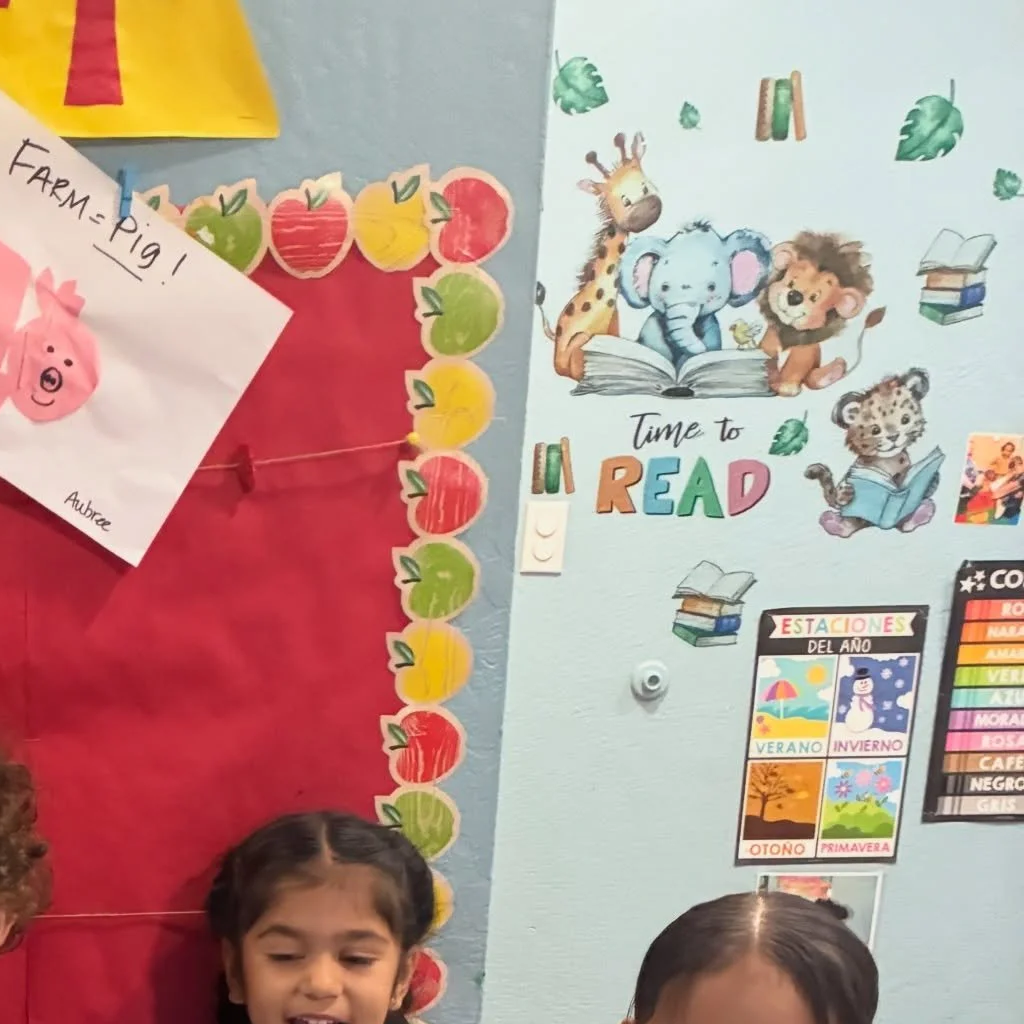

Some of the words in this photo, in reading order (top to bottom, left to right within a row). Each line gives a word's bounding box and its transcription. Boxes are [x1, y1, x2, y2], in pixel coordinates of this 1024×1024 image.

[630, 412, 705, 450] Time
[714, 416, 745, 442] to
[596, 455, 772, 519] READ
[990, 569, 1024, 589] CO
[780, 616, 907, 636] ESTACIONES
[807, 640, 834, 654] DEL
[839, 637, 872, 654] AÑO
[755, 741, 823, 755] VERANO
[833, 739, 904, 753] INVIERNO
[969, 776, 1024, 792] NEGRO
[976, 798, 1017, 813] GRIS
[749, 841, 806, 857] OTOÑO
[820, 842, 891, 854] PRIMAVERA
